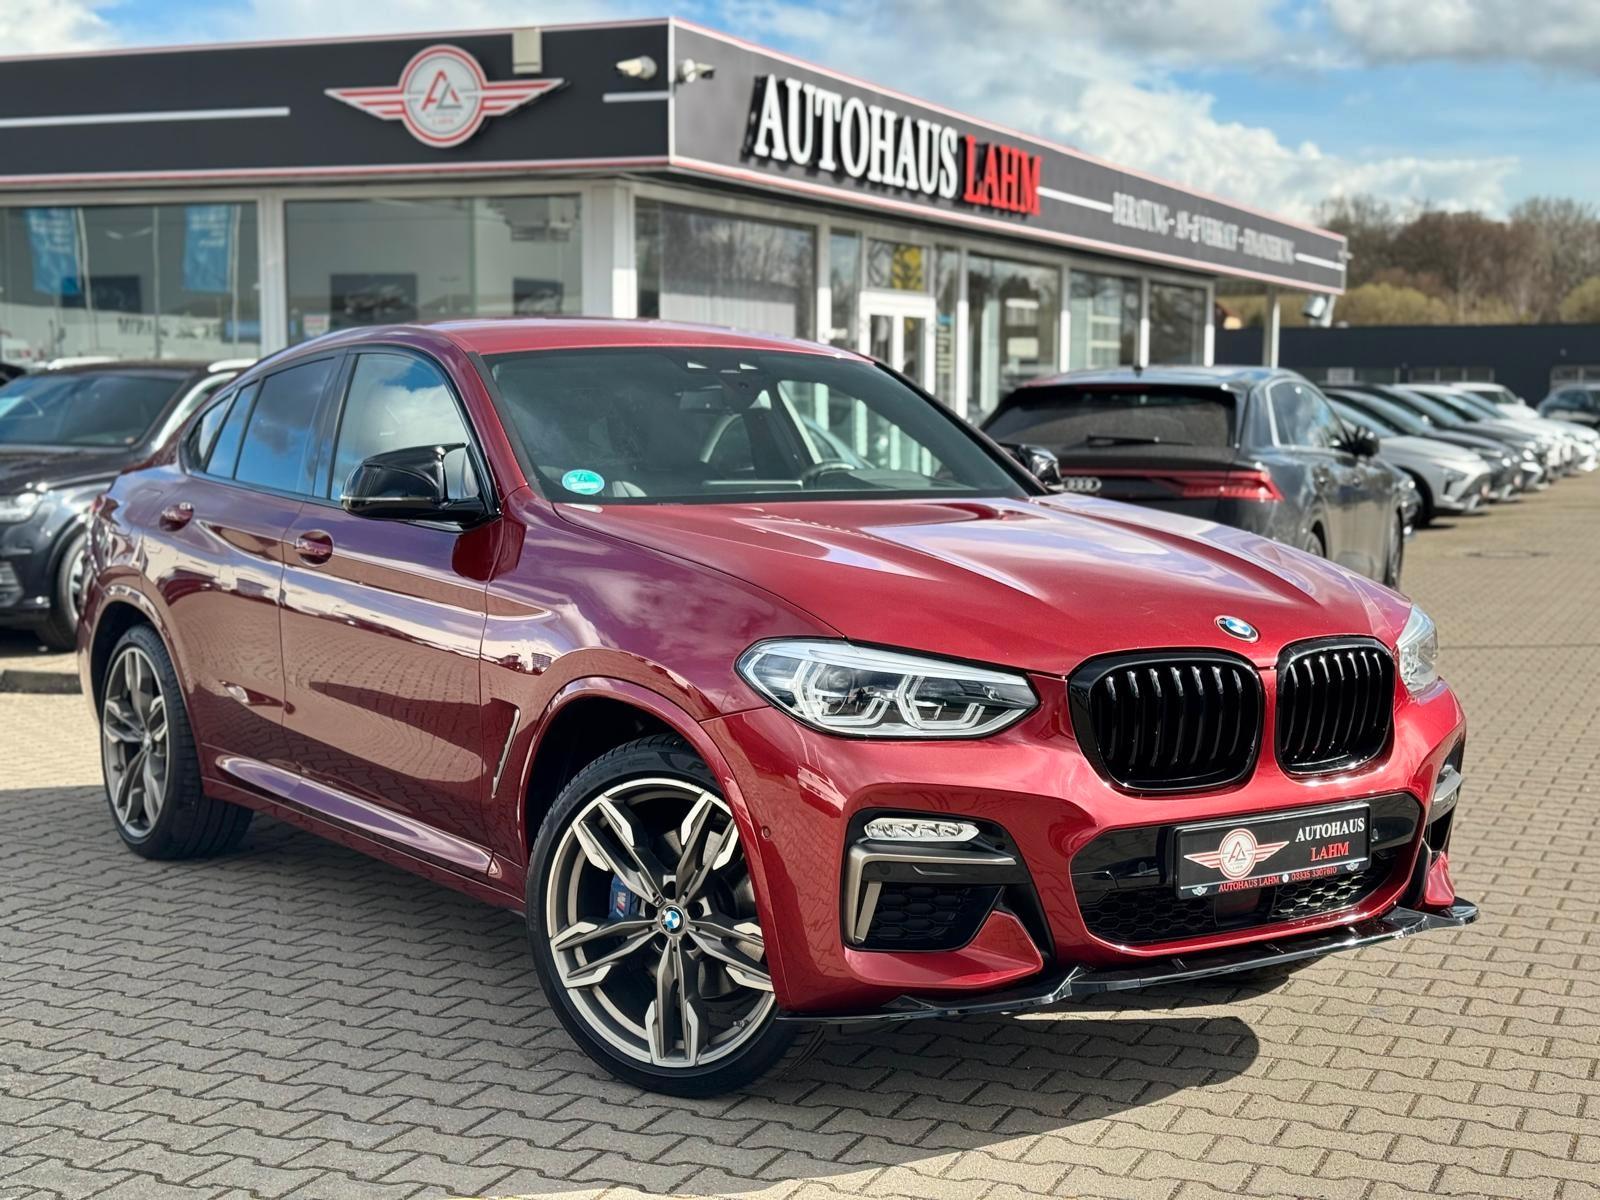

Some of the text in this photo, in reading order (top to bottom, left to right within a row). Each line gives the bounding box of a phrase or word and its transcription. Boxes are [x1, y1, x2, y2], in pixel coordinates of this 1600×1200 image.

[754, 74, 1041, 216] AUTOHAUS LAHM
[1295, 818, 1365, 842] AUTOHAUS
[1311, 841, 1350, 862] LAHM
[1218, 878, 1258, 893] AUTOHAUS
[1259, 876, 1280, 888] LAHM
